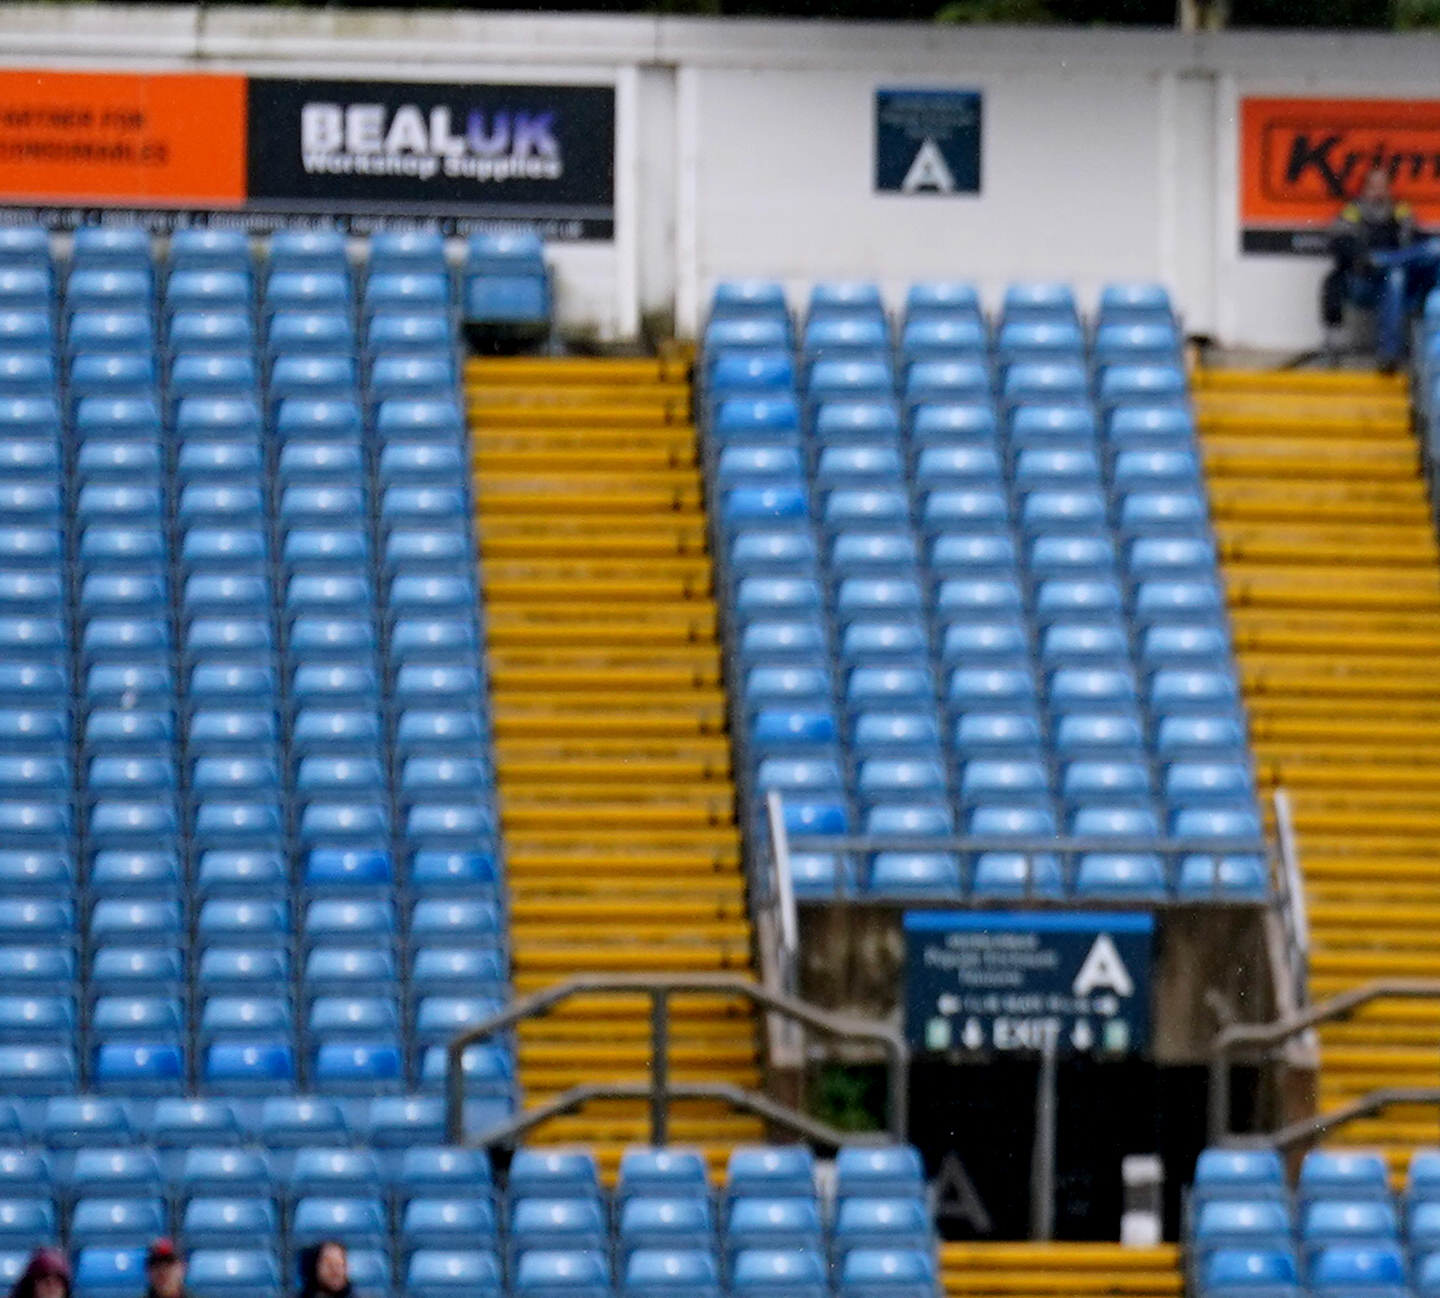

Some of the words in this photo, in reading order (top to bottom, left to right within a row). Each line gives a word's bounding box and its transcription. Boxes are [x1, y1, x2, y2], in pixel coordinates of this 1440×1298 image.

[302, 151, 435, 180] Workshop
[443, 154, 562, 181] Supplies
[901, 137, 957, 193] A
[1072, 933, 1134, 998] A
[992, 1017, 1061, 1050] EXIT
